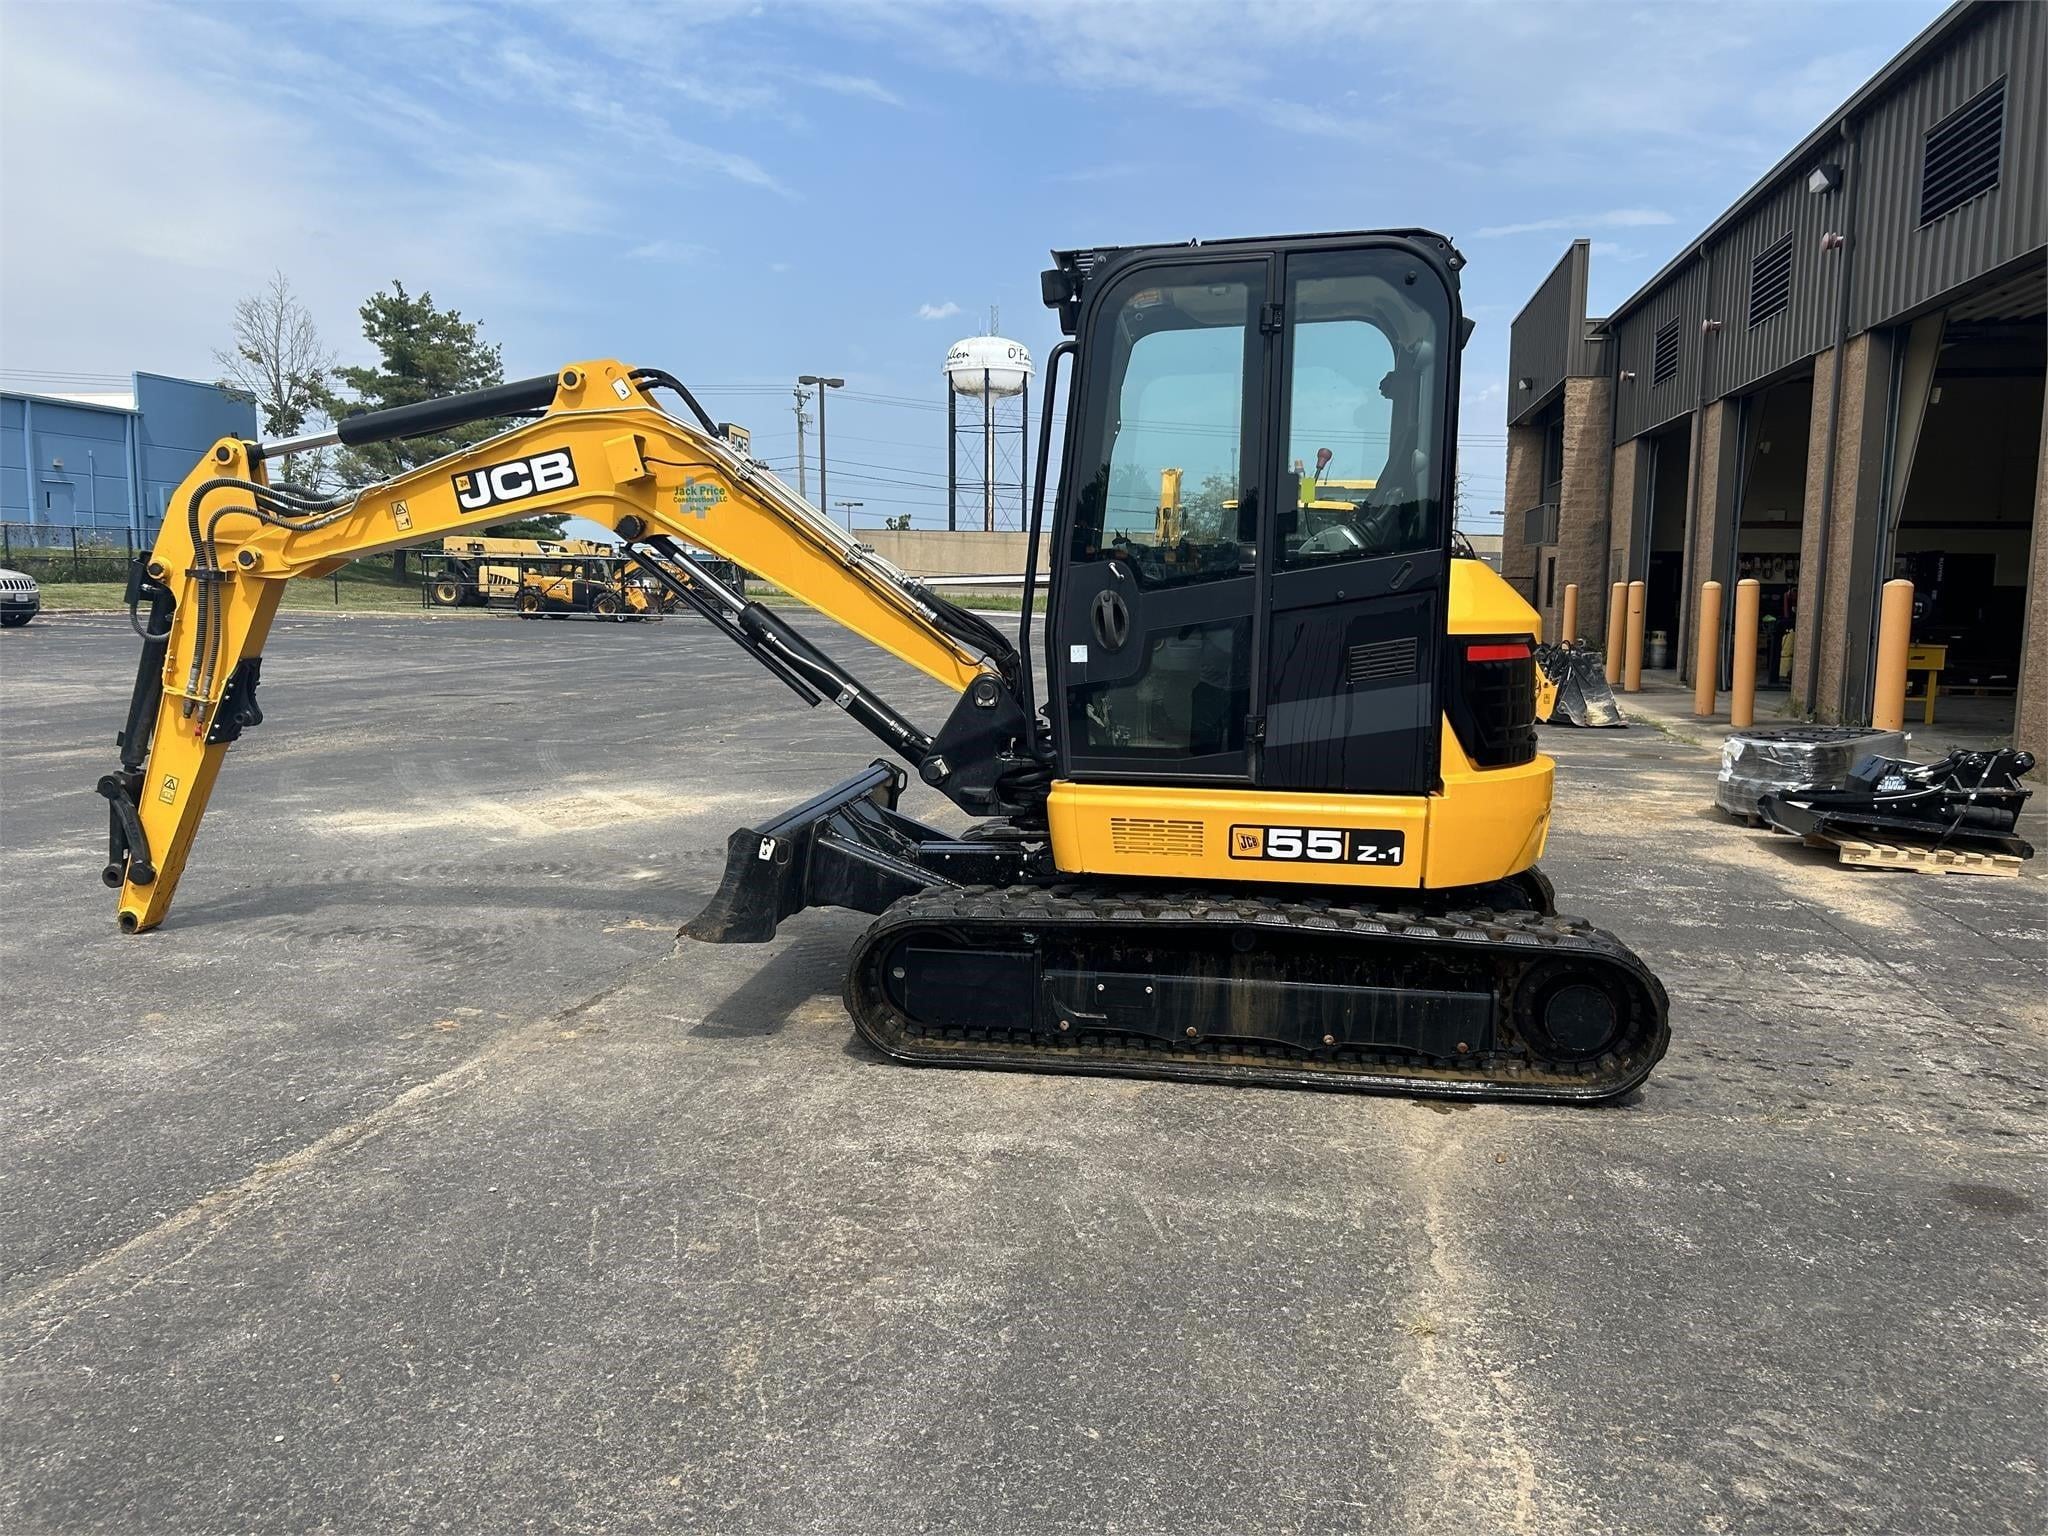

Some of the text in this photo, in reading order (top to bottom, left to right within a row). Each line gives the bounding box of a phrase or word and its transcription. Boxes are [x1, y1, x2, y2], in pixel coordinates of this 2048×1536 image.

[459, 452, 575, 509] JCB
[674, 485, 726, 496] Jack Price
[1240, 828, 1401, 863] JCB 55 Z-1
